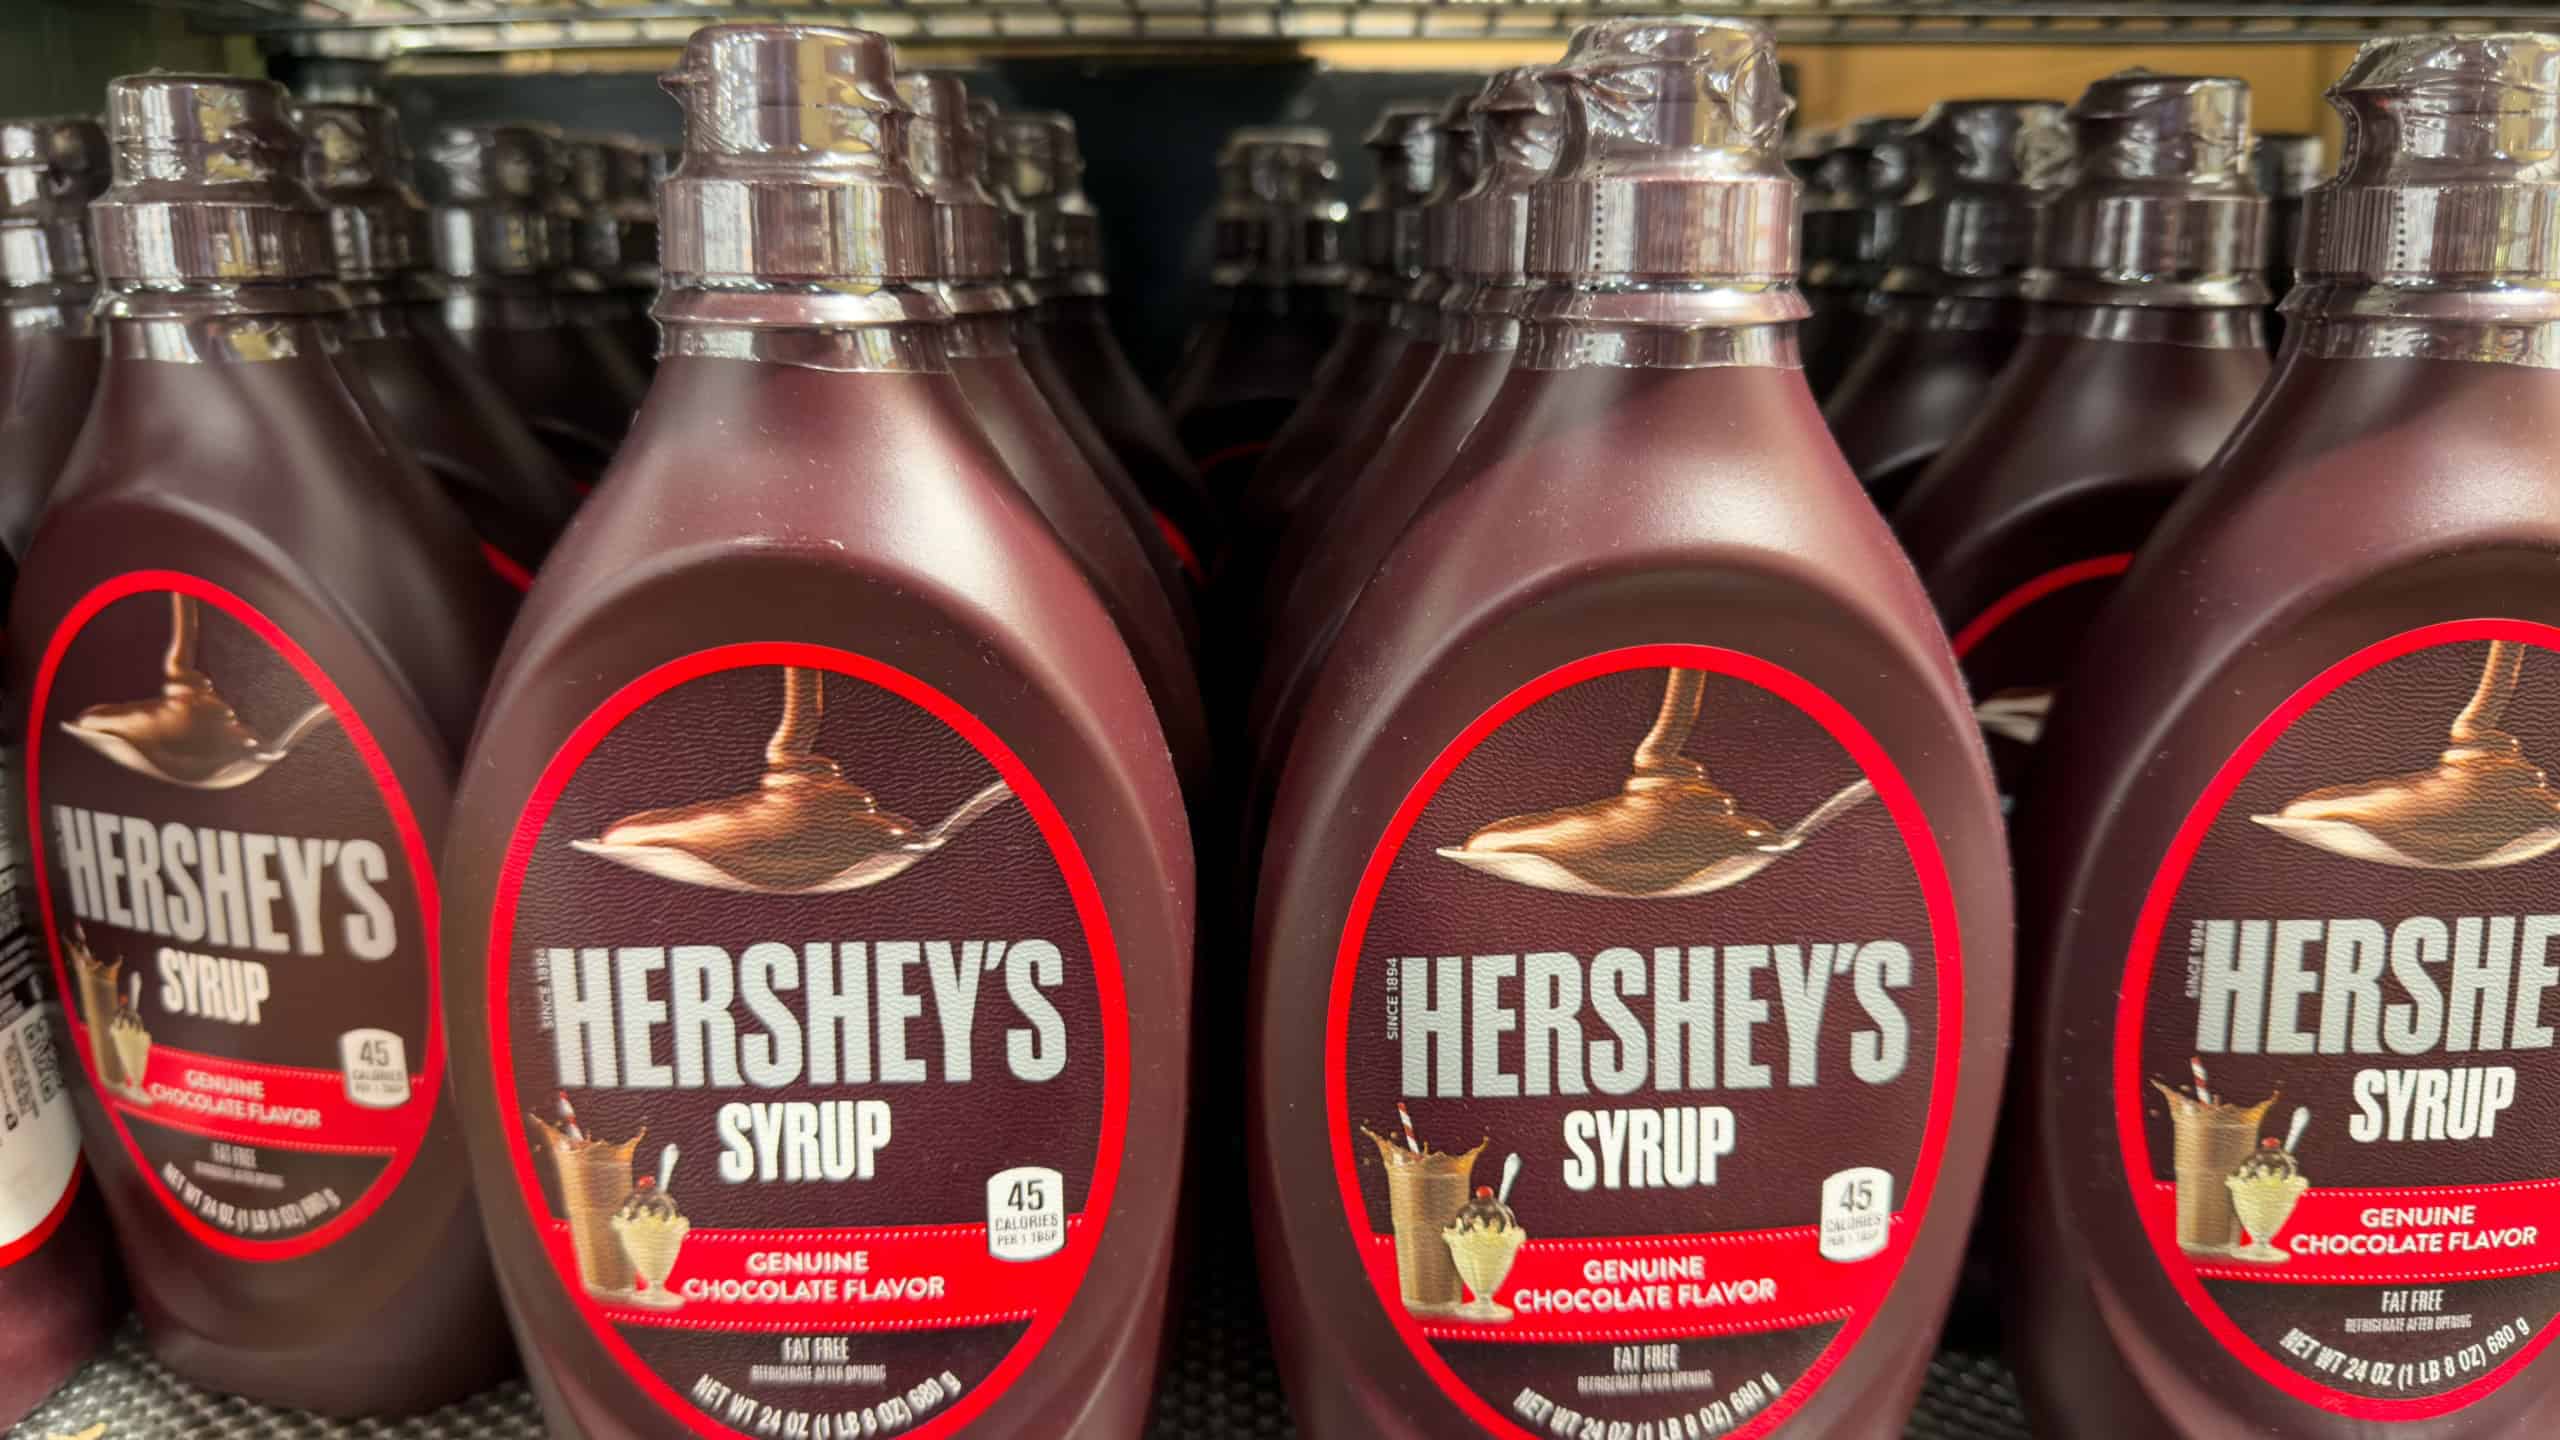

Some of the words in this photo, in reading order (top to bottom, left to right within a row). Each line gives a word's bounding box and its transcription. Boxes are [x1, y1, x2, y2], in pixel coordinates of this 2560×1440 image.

[59, 806, 398, 961] HERSHEY'S
[157, 946, 270, 1025] SYRUP
[1386, 957, 1399, 992] 1894
[548, 939, 1068, 1088] HERSHEY'S
[1386, 995, 1399, 1040] SINCE
[1401, 940, 1912, 1098] HERSHEY'S
[360, 1039, 390, 1067] 45
[184, 1069, 265, 1099] GENUINE
[150, 1083, 246, 1120] CHOCOLATE
[249, 1105, 322, 1128] FLAVOR
[2349, 1066, 2517, 1143] SYRUP
[718, 1099, 893, 1184] SYRUP
[1563, 1106, 1736, 1191] SYRUP
[1008, 1180, 1044, 1211] 45
[1840, 1180, 1873, 1211] 45
[995, 1214, 1058, 1232] CALORIES
[2360, 1205, 2477, 1229] GENUINE
[2290, 1232, 2443, 1255] CHOCOLATE
[2447, 1226, 2538, 1251] FLAVOR
[747, 1250, 870, 1274] GENUINE
[1583, 1256, 1706, 1283] GENUINE
[682, 1278, 838, 1302] CHOCOLATE
[843, 1275, 945, 1301] FLAVOR
[1514, 1285, 1671, 1312] CHOCOLATE
[1678, 1278, 1777, 1306] FLAVOR
[2381, 1290, 2410, 1313] FAT
[2410, 1289, 2446, 1312] FREE
[2344, 1316, 2405, 1333] REFRIGERATE
[2406, 1315, 2435, 1332] AFTER
[781, 1336, 811, 1361] FAT
[812, 1336, 850, 1361] FREE
[1613, 1346, 1641, 1373] FAT
[1643, 1344, 1681, 1372] FREE
[2279, 1328, 2321, 1360] NET
[2314, 1345, 2347, 1374] WT
[2342, 1357, 2369, 1383] 24
[2370, 1361, 2395, 1386] OZ
[2397, 1363, 2414, 1391] (1
[2420, 1359, 2441, 1385] LB
[2445, 1355, 2456, 1378] 8
[2458, 1343, 2487, 1371] OZ)
[2485, 1324, 2516, 1355] 680
[2515, 1317, 2531, 1336] g
[691, 1373, 731, 1406] NET
[727, 1393, 759, 1425] WT
[756, 1405, 782, 1438] 24
[784, 1411, 811, 1439] OZ
[813, 1412, 831, 1440] (1
[833, 1410, 861, 1438] LB
[862, 1407, 878, 1430] 8
[876, 1396, 913, 1430] OZ)
[907, 1377, 946, 1411] 680
[938, 1370, 962, 1397] g
[1513, 1387, 1553, 1425] NET
[1550, 1405, 1582, 1437] WT
[1579, 1416, 1606, 1440] 24
[1658, 1416, 1684, 1440] LB
[1684, 1413, 1701, 1438] 8
[1699, 1400, 1735, 1434] OZ)
[1729, 1380, 1766, 1417] 680
